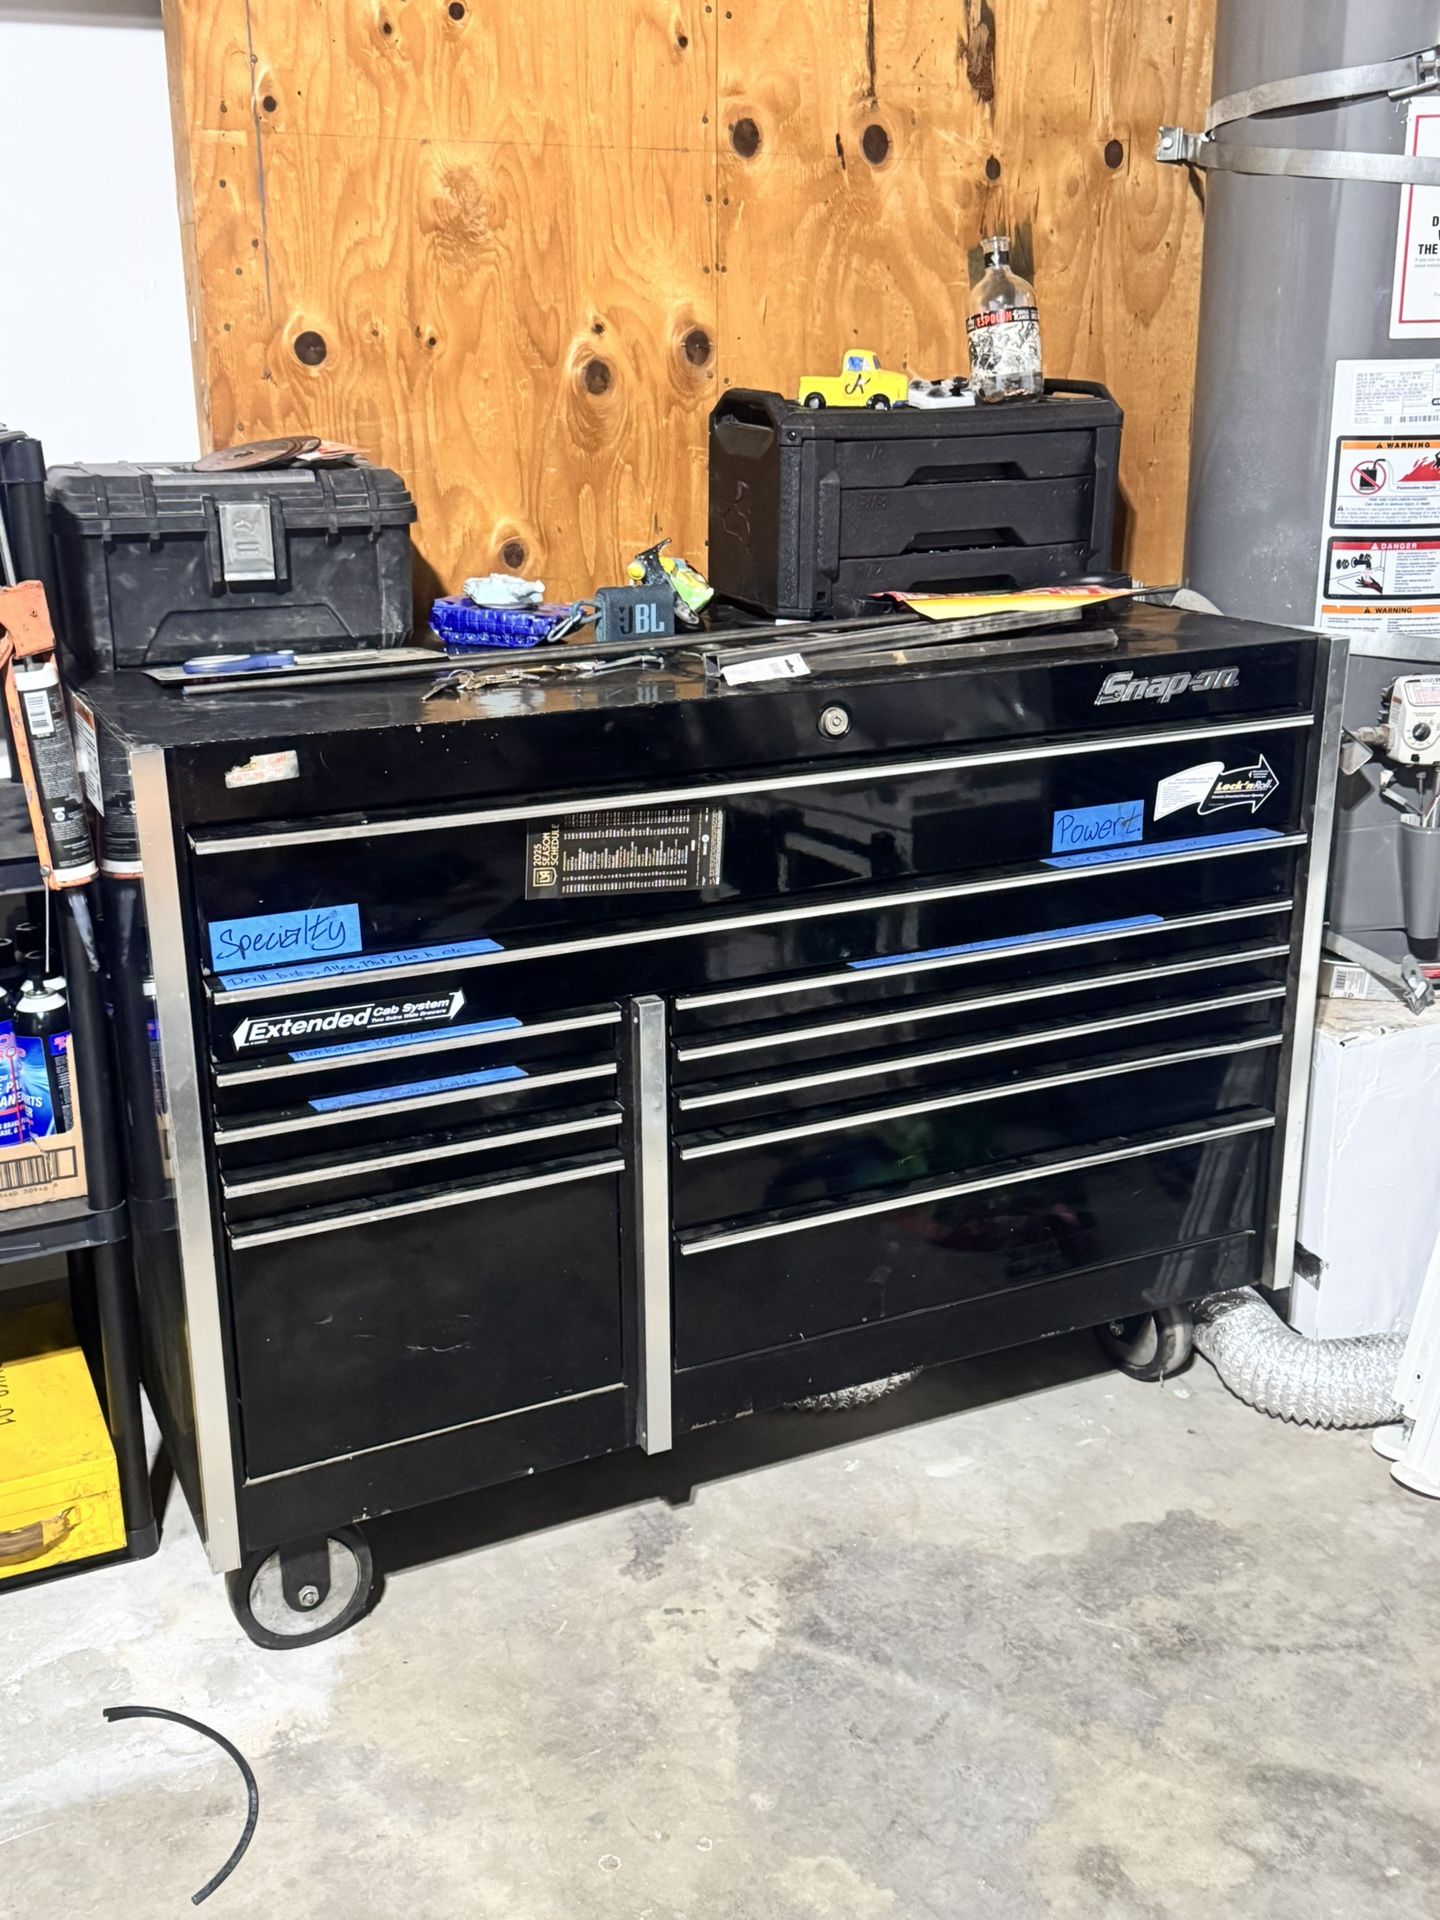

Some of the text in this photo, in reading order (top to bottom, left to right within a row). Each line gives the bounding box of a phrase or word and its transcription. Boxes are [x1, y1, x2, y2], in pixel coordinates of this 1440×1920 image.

[1418, 243, 1438, 255] THE
[844, 373, 871, 394] K
[619, 603, 665, 634] JBL
[1094, 667, 1239, 705] Snap-on
[533, 844, 542, 866] 2025
[542, 832, 550, 866] SEASON
[551, 824, 560, 866] SCHEDULE
[216, 914, 346, 960] Specialty
[248, 1000, 449, 1040] Extended Cab System
